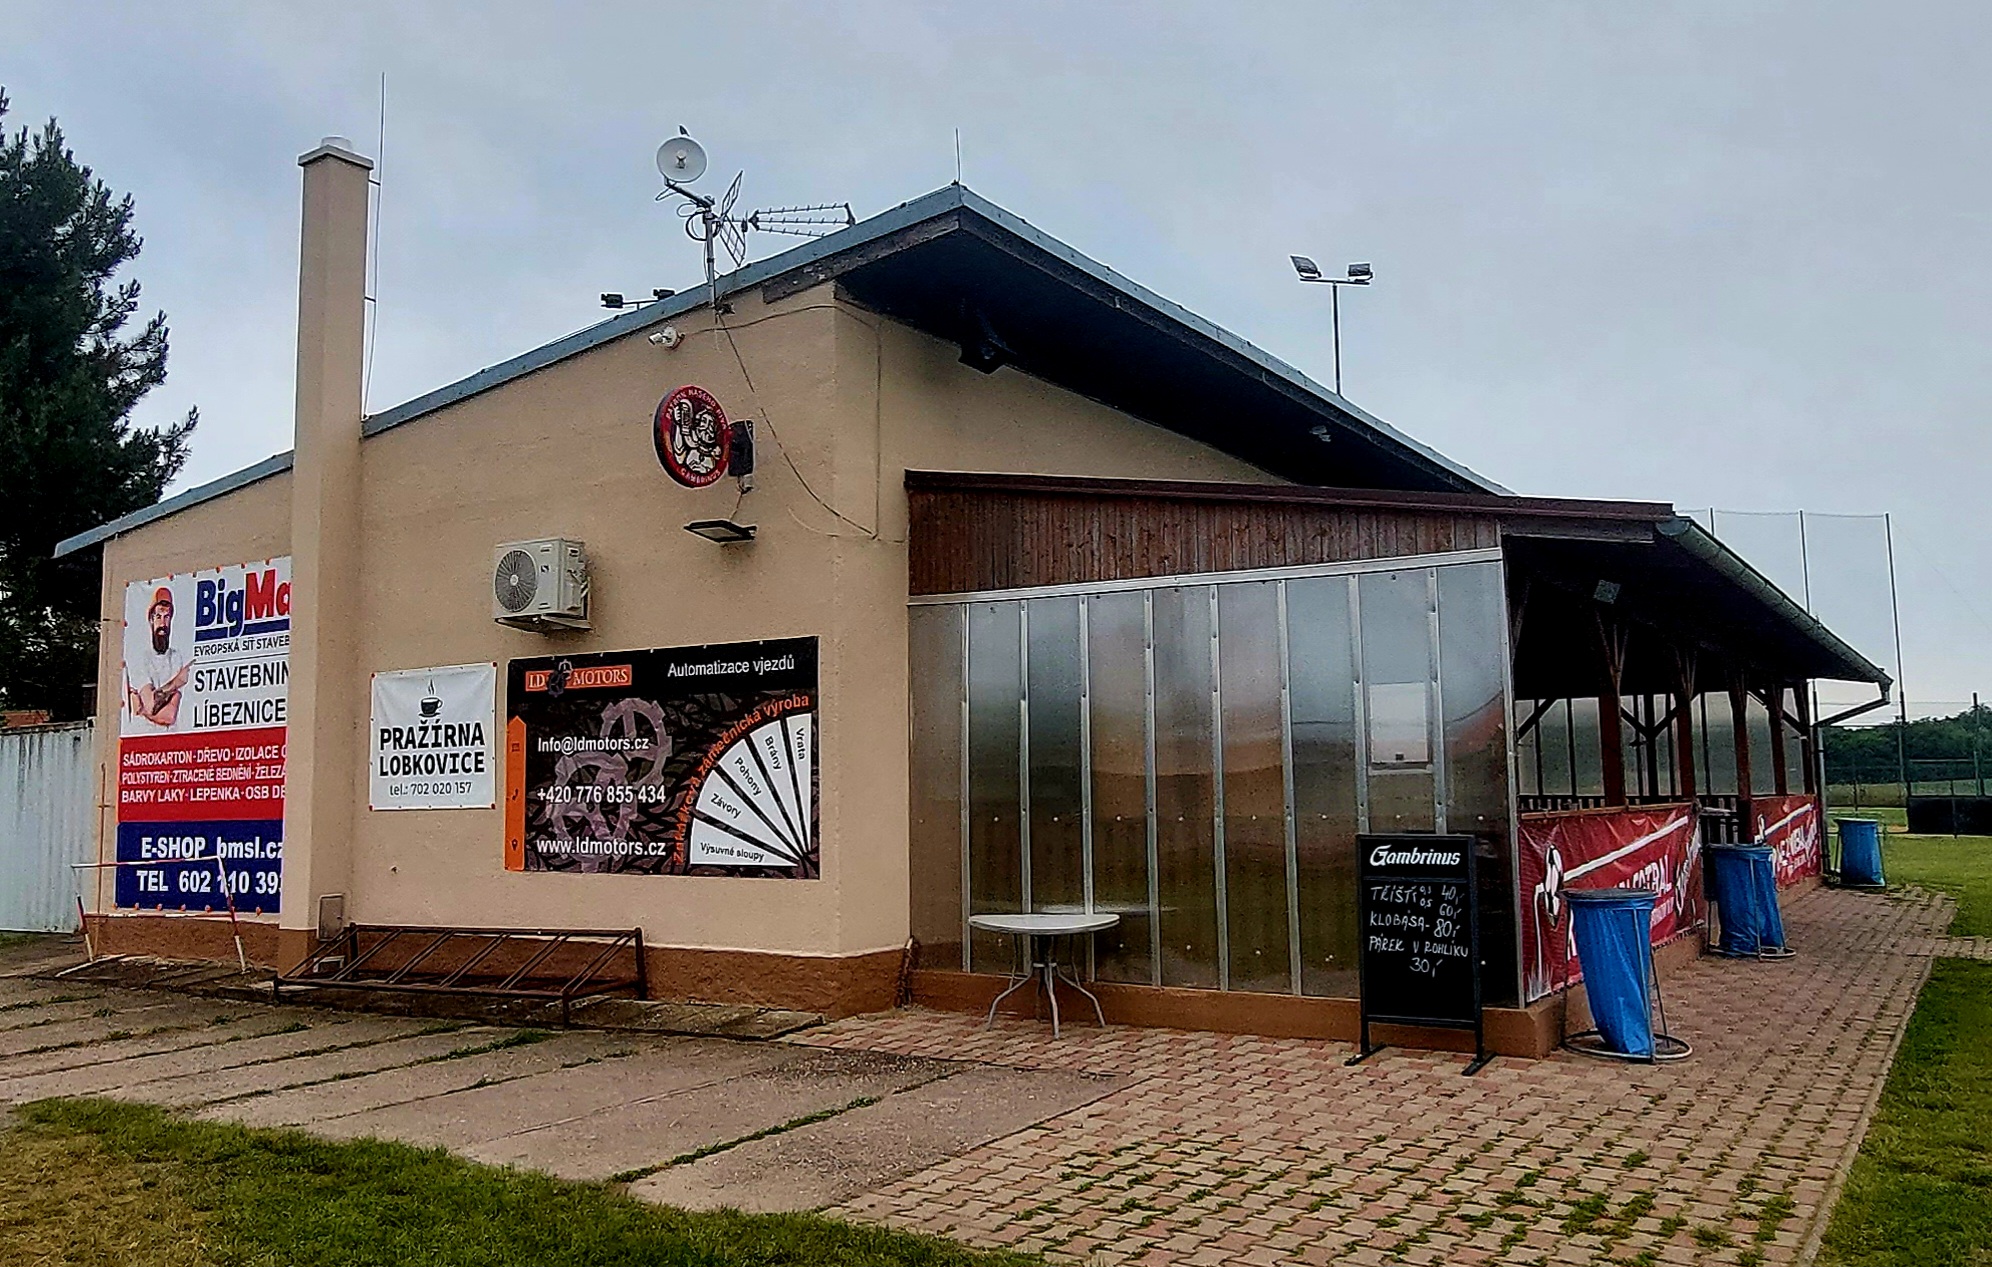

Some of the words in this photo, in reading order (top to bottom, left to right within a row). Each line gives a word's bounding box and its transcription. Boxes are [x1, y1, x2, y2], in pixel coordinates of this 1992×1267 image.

[194, 638, 240, 657] EVROPSKÁ
[667, 659, 750, 677] Automatizace
[752, 654, 795, 675] vjezdů
[528, 673, 545, 688] LD
[572, 668, 629, 686] MOTORS
[193, 698, 287, 728] LÍBEZNICE
[379, 719, 485, 751] PRAŽÍRNA
[697, 710, 761, 776] zámečnická
[763, 694, 809, 717] výroba
[795, 728, 806, 760] Vrata
[122, 750, 193, 767] SÁDROKARTON
[196, 747, 231, 763] DŘEVO
[235, 745, 279, 760] IZOLACE
[379, 751, 485, 777] LOBKOVICE
[764, 736, 782, 771] Brány
[734, 757, 762, 796] Pohony
[121, 788, 156, 803] BARVY
[157, 788, 185, 803] LAKY
[190, 786, 241, 802] LEPENKA
[245, 785, 270, 800] OSB
[390, 783, 408, 796] tel.:
[411, 783, 429, 795] 702
[432, 782, 451, 795] 020
[455, 781, 472, 794] 157
[537, 785, 572, 803] +420
[575, 785, 603, 803] 776
[606, 785, 634, 803] 855
[638, 784, 666, 803] 434
[710, 793, 742, 819] Závory
[141, 837, 206, 859] E-SHOP
[216, 836, 283, 859] bmsl.cz
[537, 836, 667, 857] www.ldmotors.cz
[700, 842, 735, 857] Výsuvné
[736, 850, 765, 863] sloupy
[1369, 844, 1461, 866] Gambrinus
[136, 870, 169, 891] TEL
[178, 870, 211, 893] 602
[217, 870, 250, 894] 110
[255, 871, 282, 894] 39
[1369, 933, 1405, 953] PÁREK
[1424, 940, 1469, 958] ROHLÍKU
